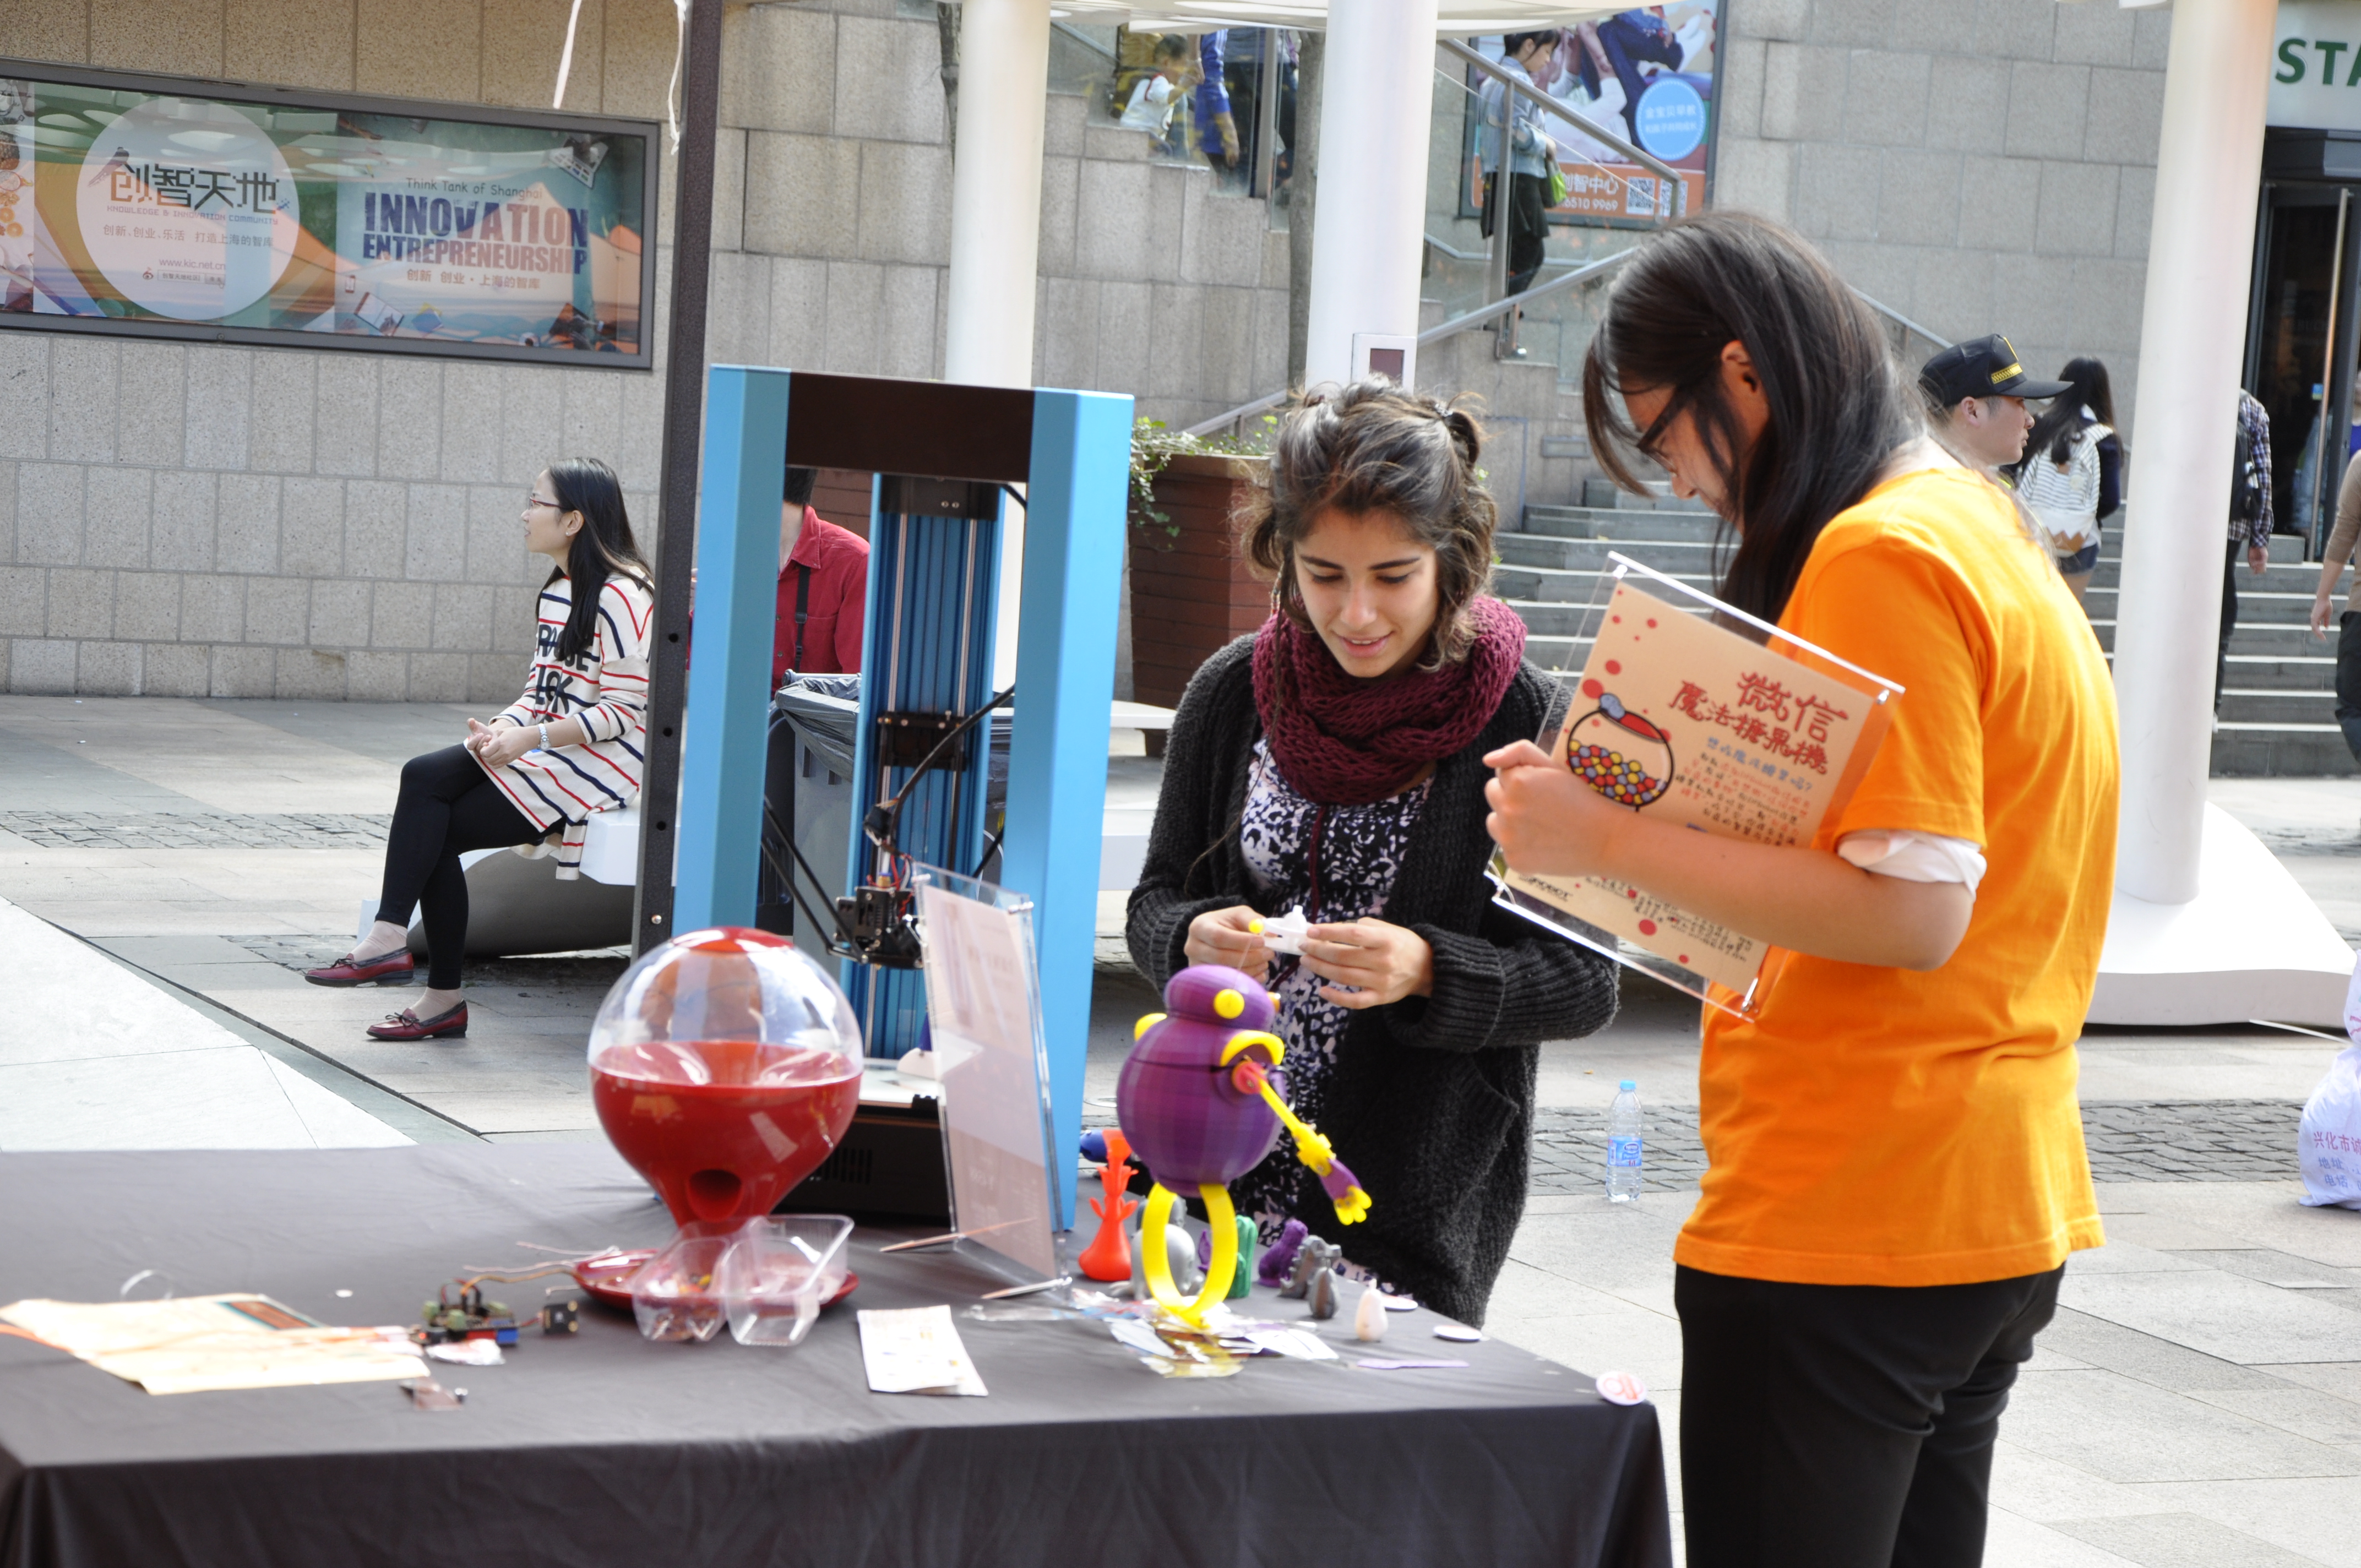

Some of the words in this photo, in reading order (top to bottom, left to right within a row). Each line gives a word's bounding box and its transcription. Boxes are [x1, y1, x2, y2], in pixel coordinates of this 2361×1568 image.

[111, 162, 280, 214] 创智天地
[406, 177, 437, 190] Think
[443, 181, 468, 193] Tank
[474, 183, 486, 194] of
[491, 185, 542, 200] Shanghai
[107, 205, 159, 216] KNOWLEDGE
[173, 211, 225, 221] INNOVATION
[229, 215, 279, 225] COMMUNITY
[365, 192, 589, 248] INNOVATION
[159, 258, 226, 270] www.kic.net.cn
[363, 233, 587, 274] ENTREPRENEURSHIP
[407, 269, 432, 282] 创新
[1736, 671, 1849, 743] 微信
